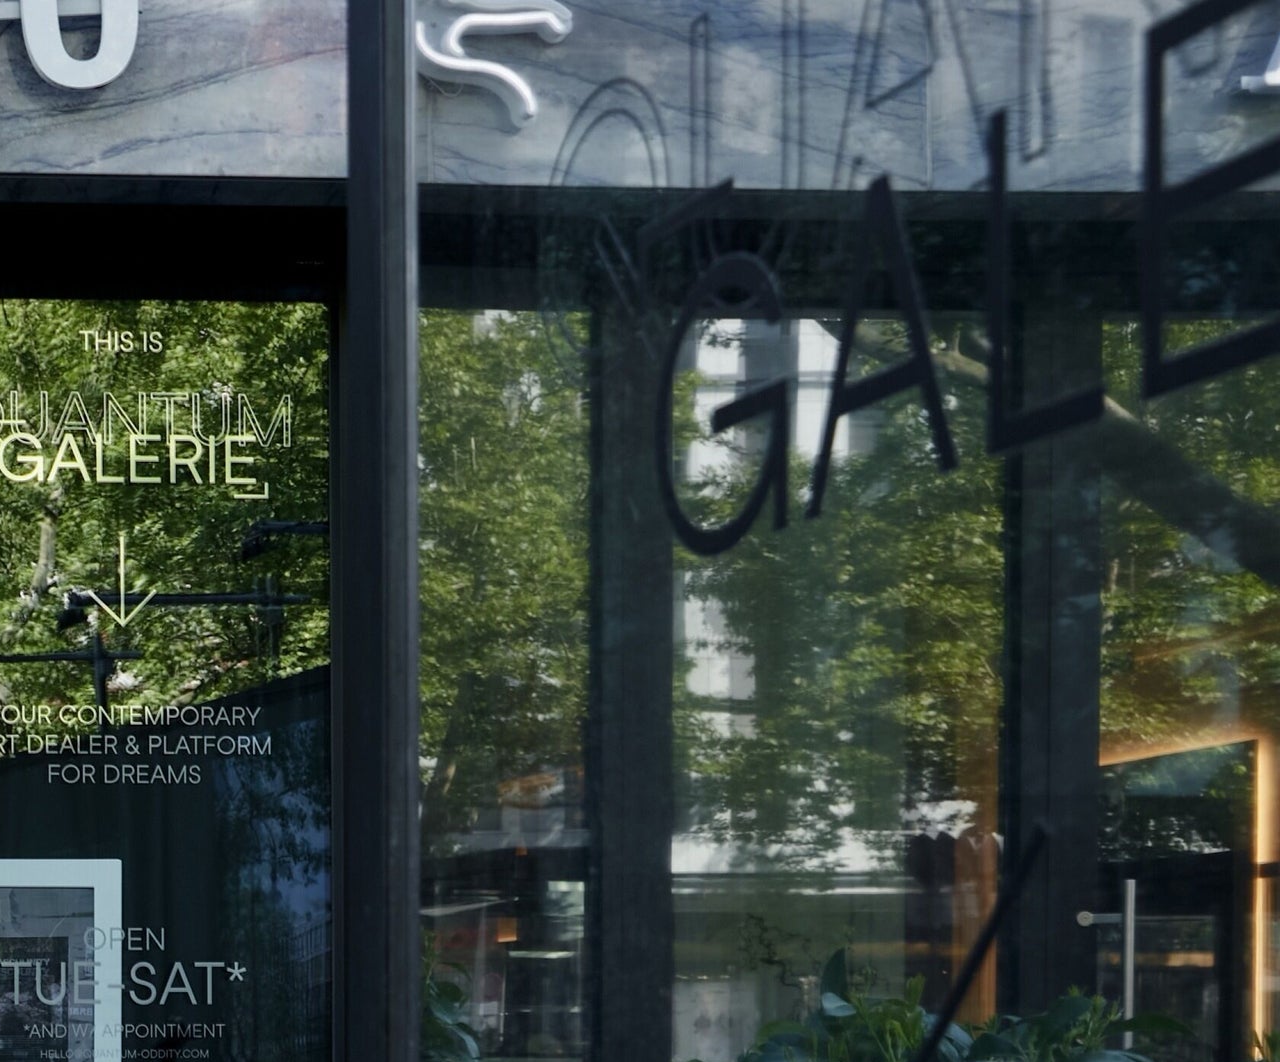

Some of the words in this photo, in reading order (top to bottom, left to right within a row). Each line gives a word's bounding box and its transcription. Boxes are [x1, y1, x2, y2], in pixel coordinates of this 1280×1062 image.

[79, 331, 134, 353] THIS
[142, 331, 163, 353] IS
[59, 705, 262, 727] CONTEMPORARY
[27, 735, 118, 755] DEALER
[125, 735, 141, 755] &
[149, 735, 272, 756] PLATFORM
[48, 764, 96, 785] FOR
[104, 764, 202, 785] DREAMS
[83, 927, 166, 951] OPEN
[102, 1023, 227, 1039] APPOINTMENT
